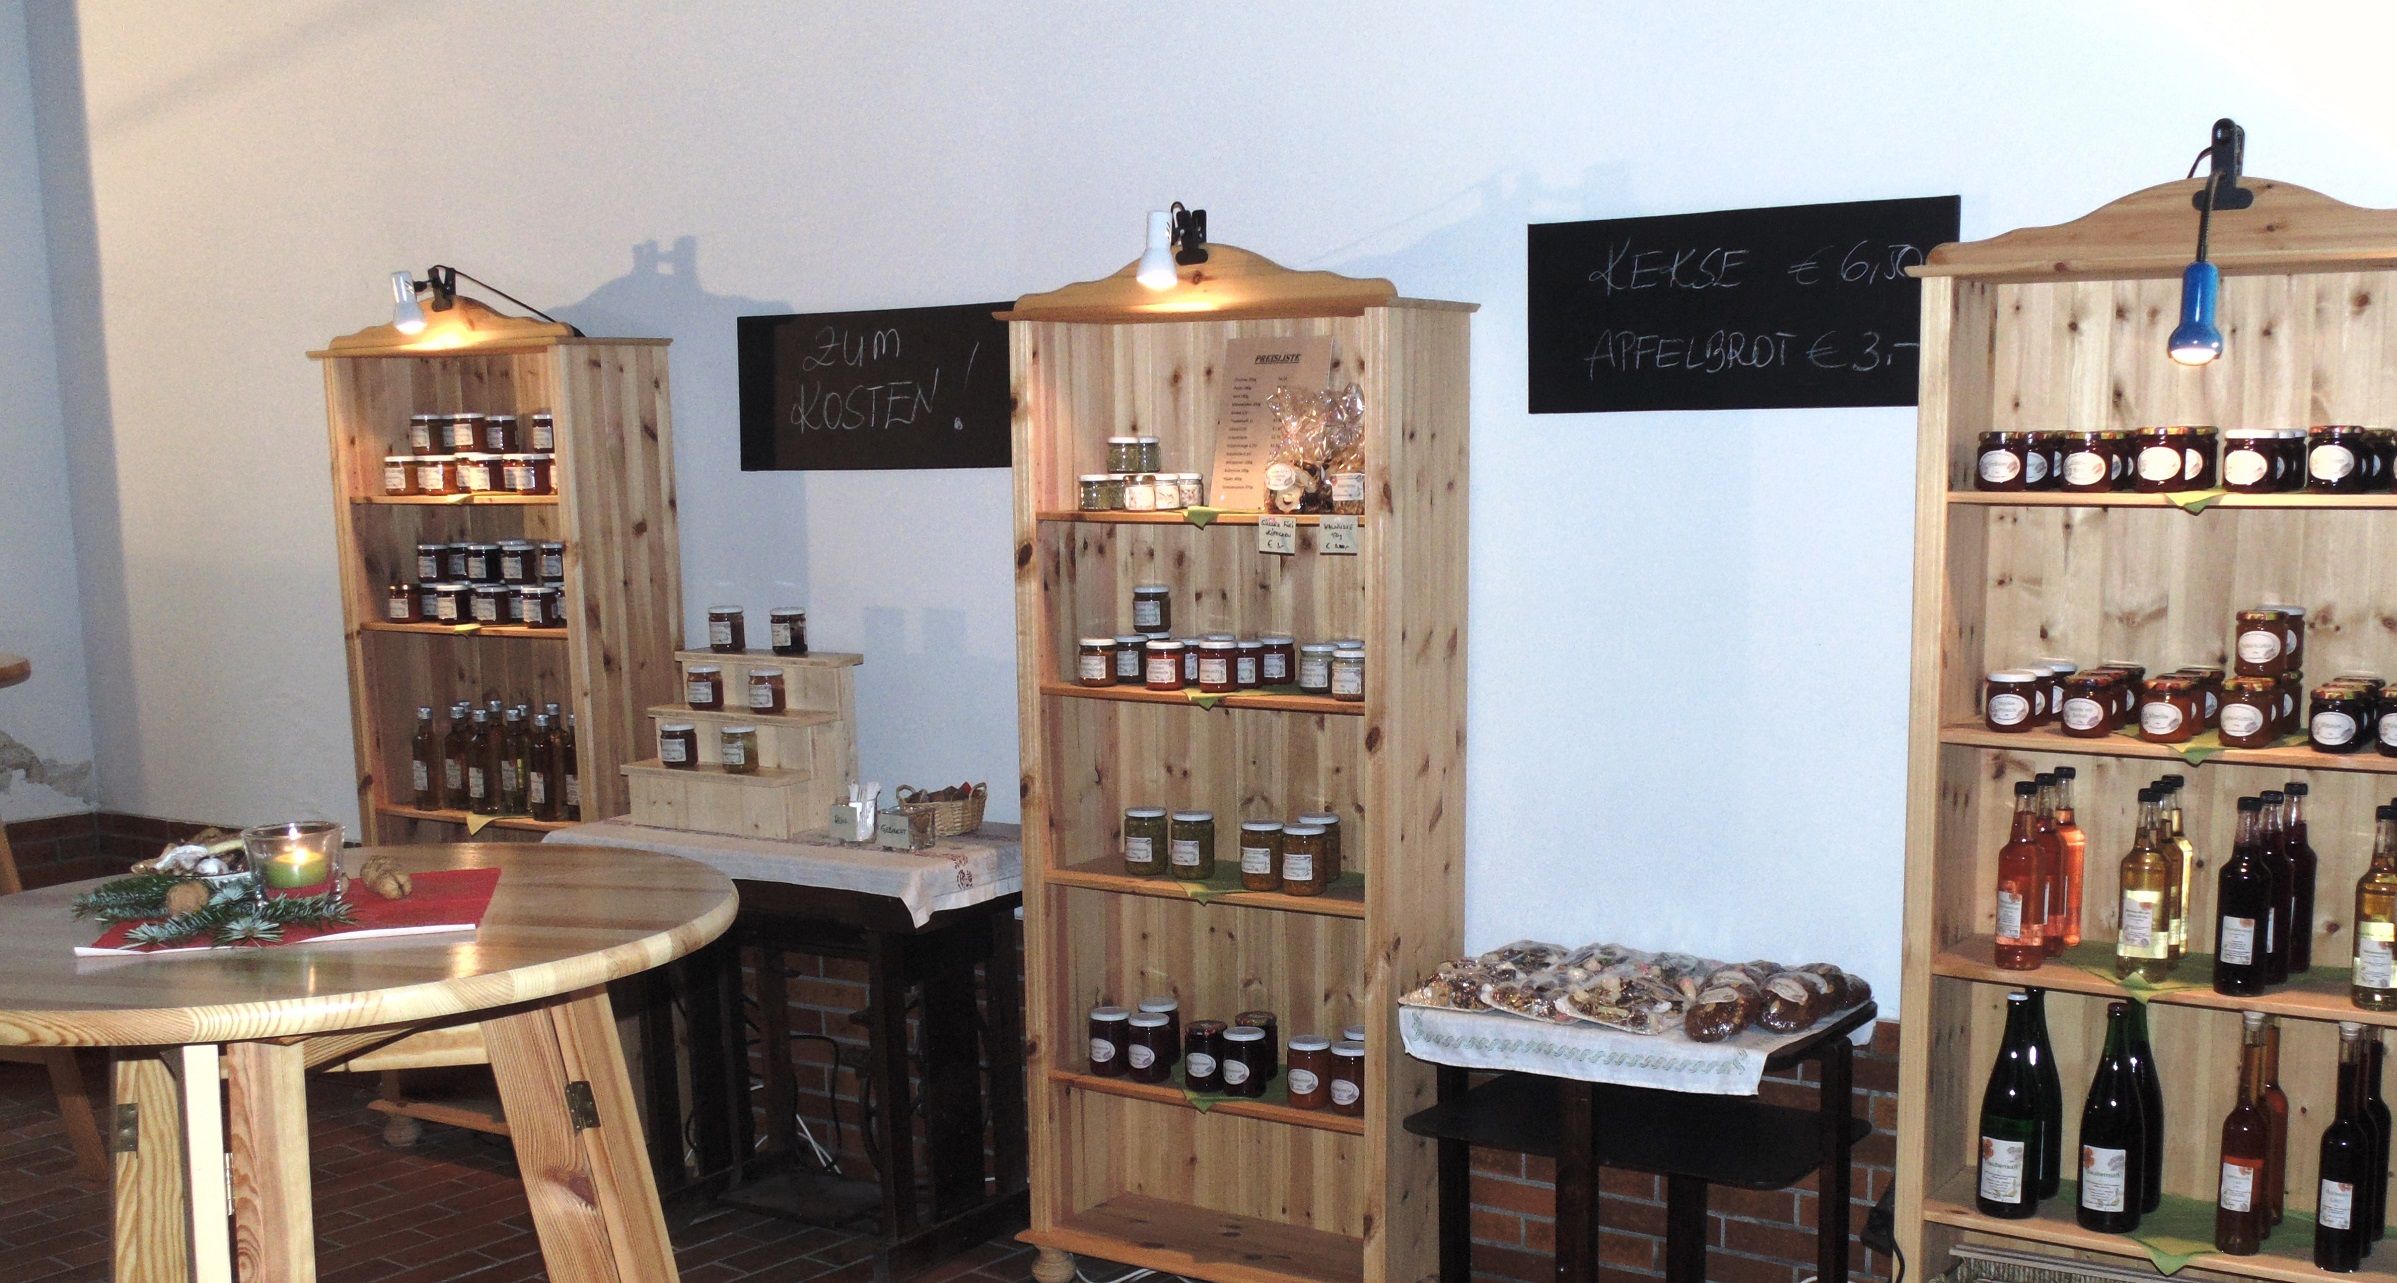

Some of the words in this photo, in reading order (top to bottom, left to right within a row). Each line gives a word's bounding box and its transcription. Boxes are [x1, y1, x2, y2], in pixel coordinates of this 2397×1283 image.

[1589, 238, 1749, 295] KEKSE
[1788, 245, 1835, 285] €
[1841, 240, 1923, 285] 6,50
[803, 326, 900, 372] ZUM
[1585, 330, 1796, 381] APFELBROT
[1806, 330, 1847, 369] €
